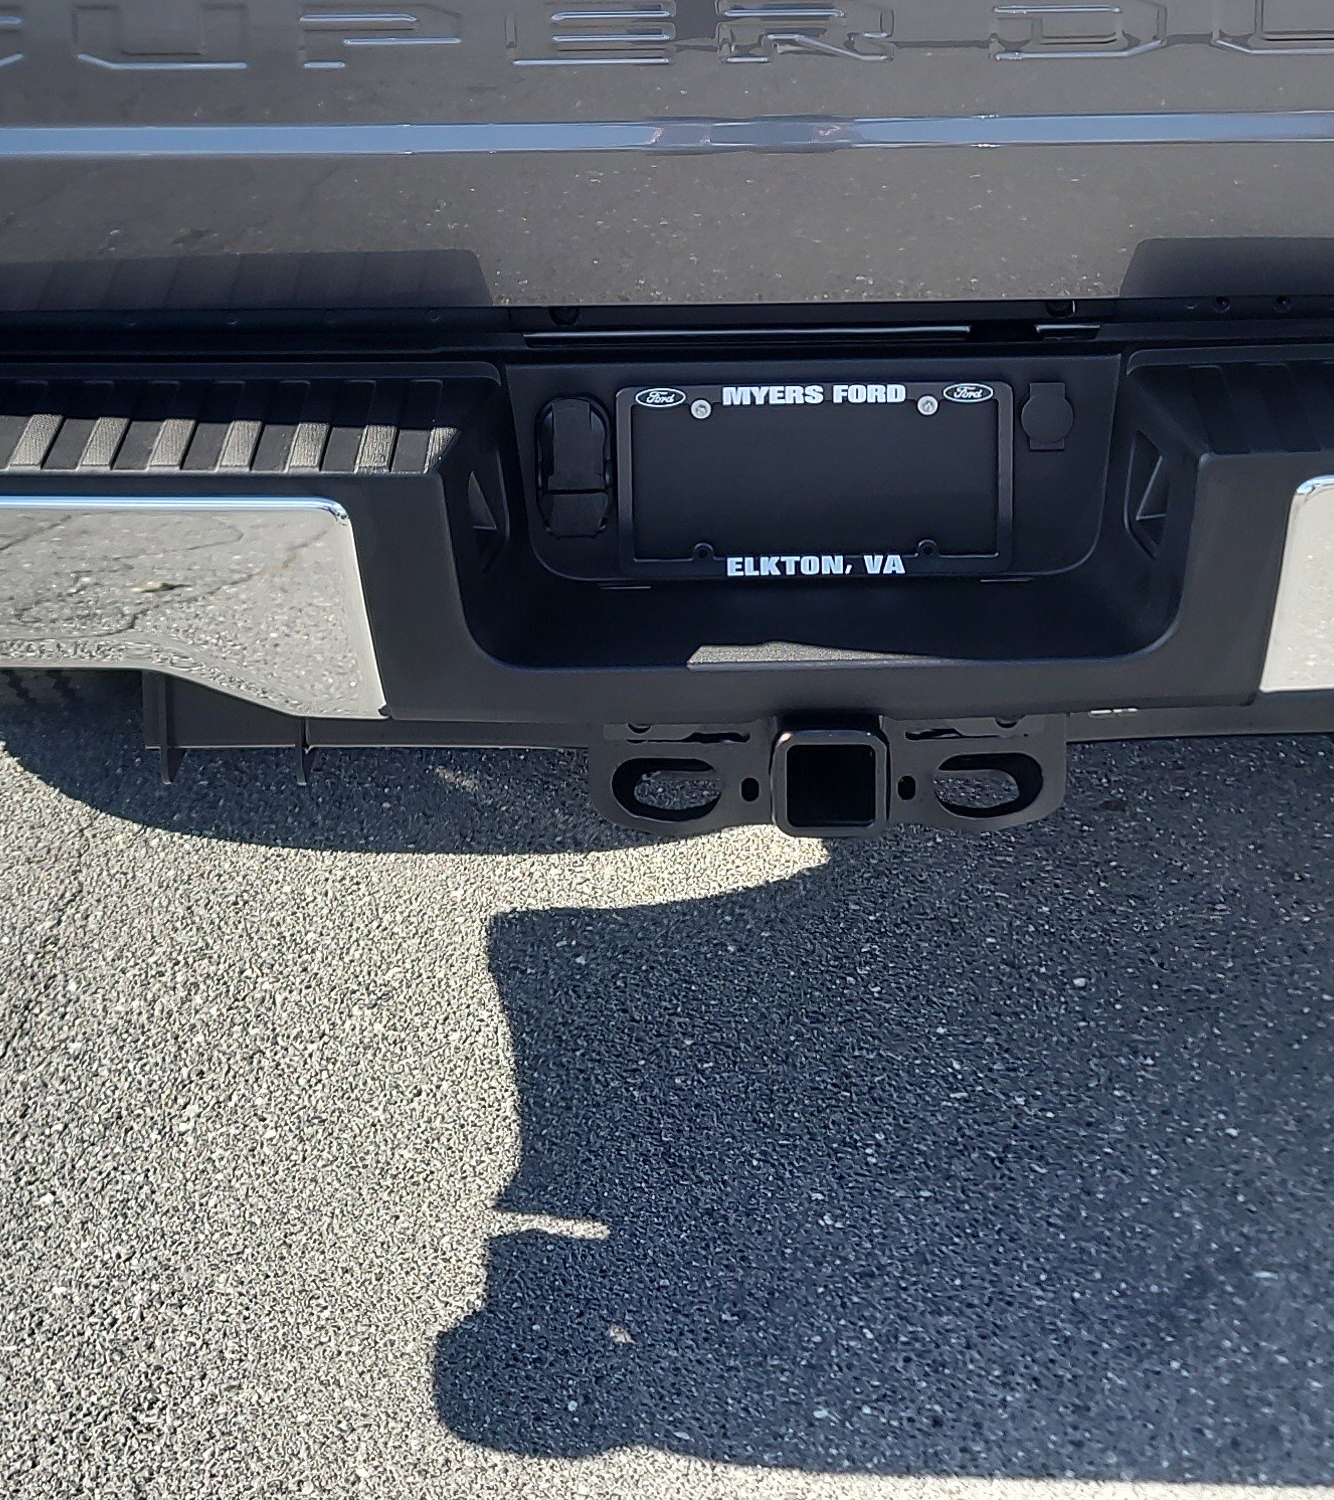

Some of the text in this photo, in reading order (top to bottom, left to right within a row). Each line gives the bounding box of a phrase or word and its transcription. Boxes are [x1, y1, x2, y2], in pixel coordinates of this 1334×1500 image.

[722, 385, 824, 406] MYERS
[832, 384, 906, 403] FORD
[726, 555, 906, 577] ELKTON, VA
